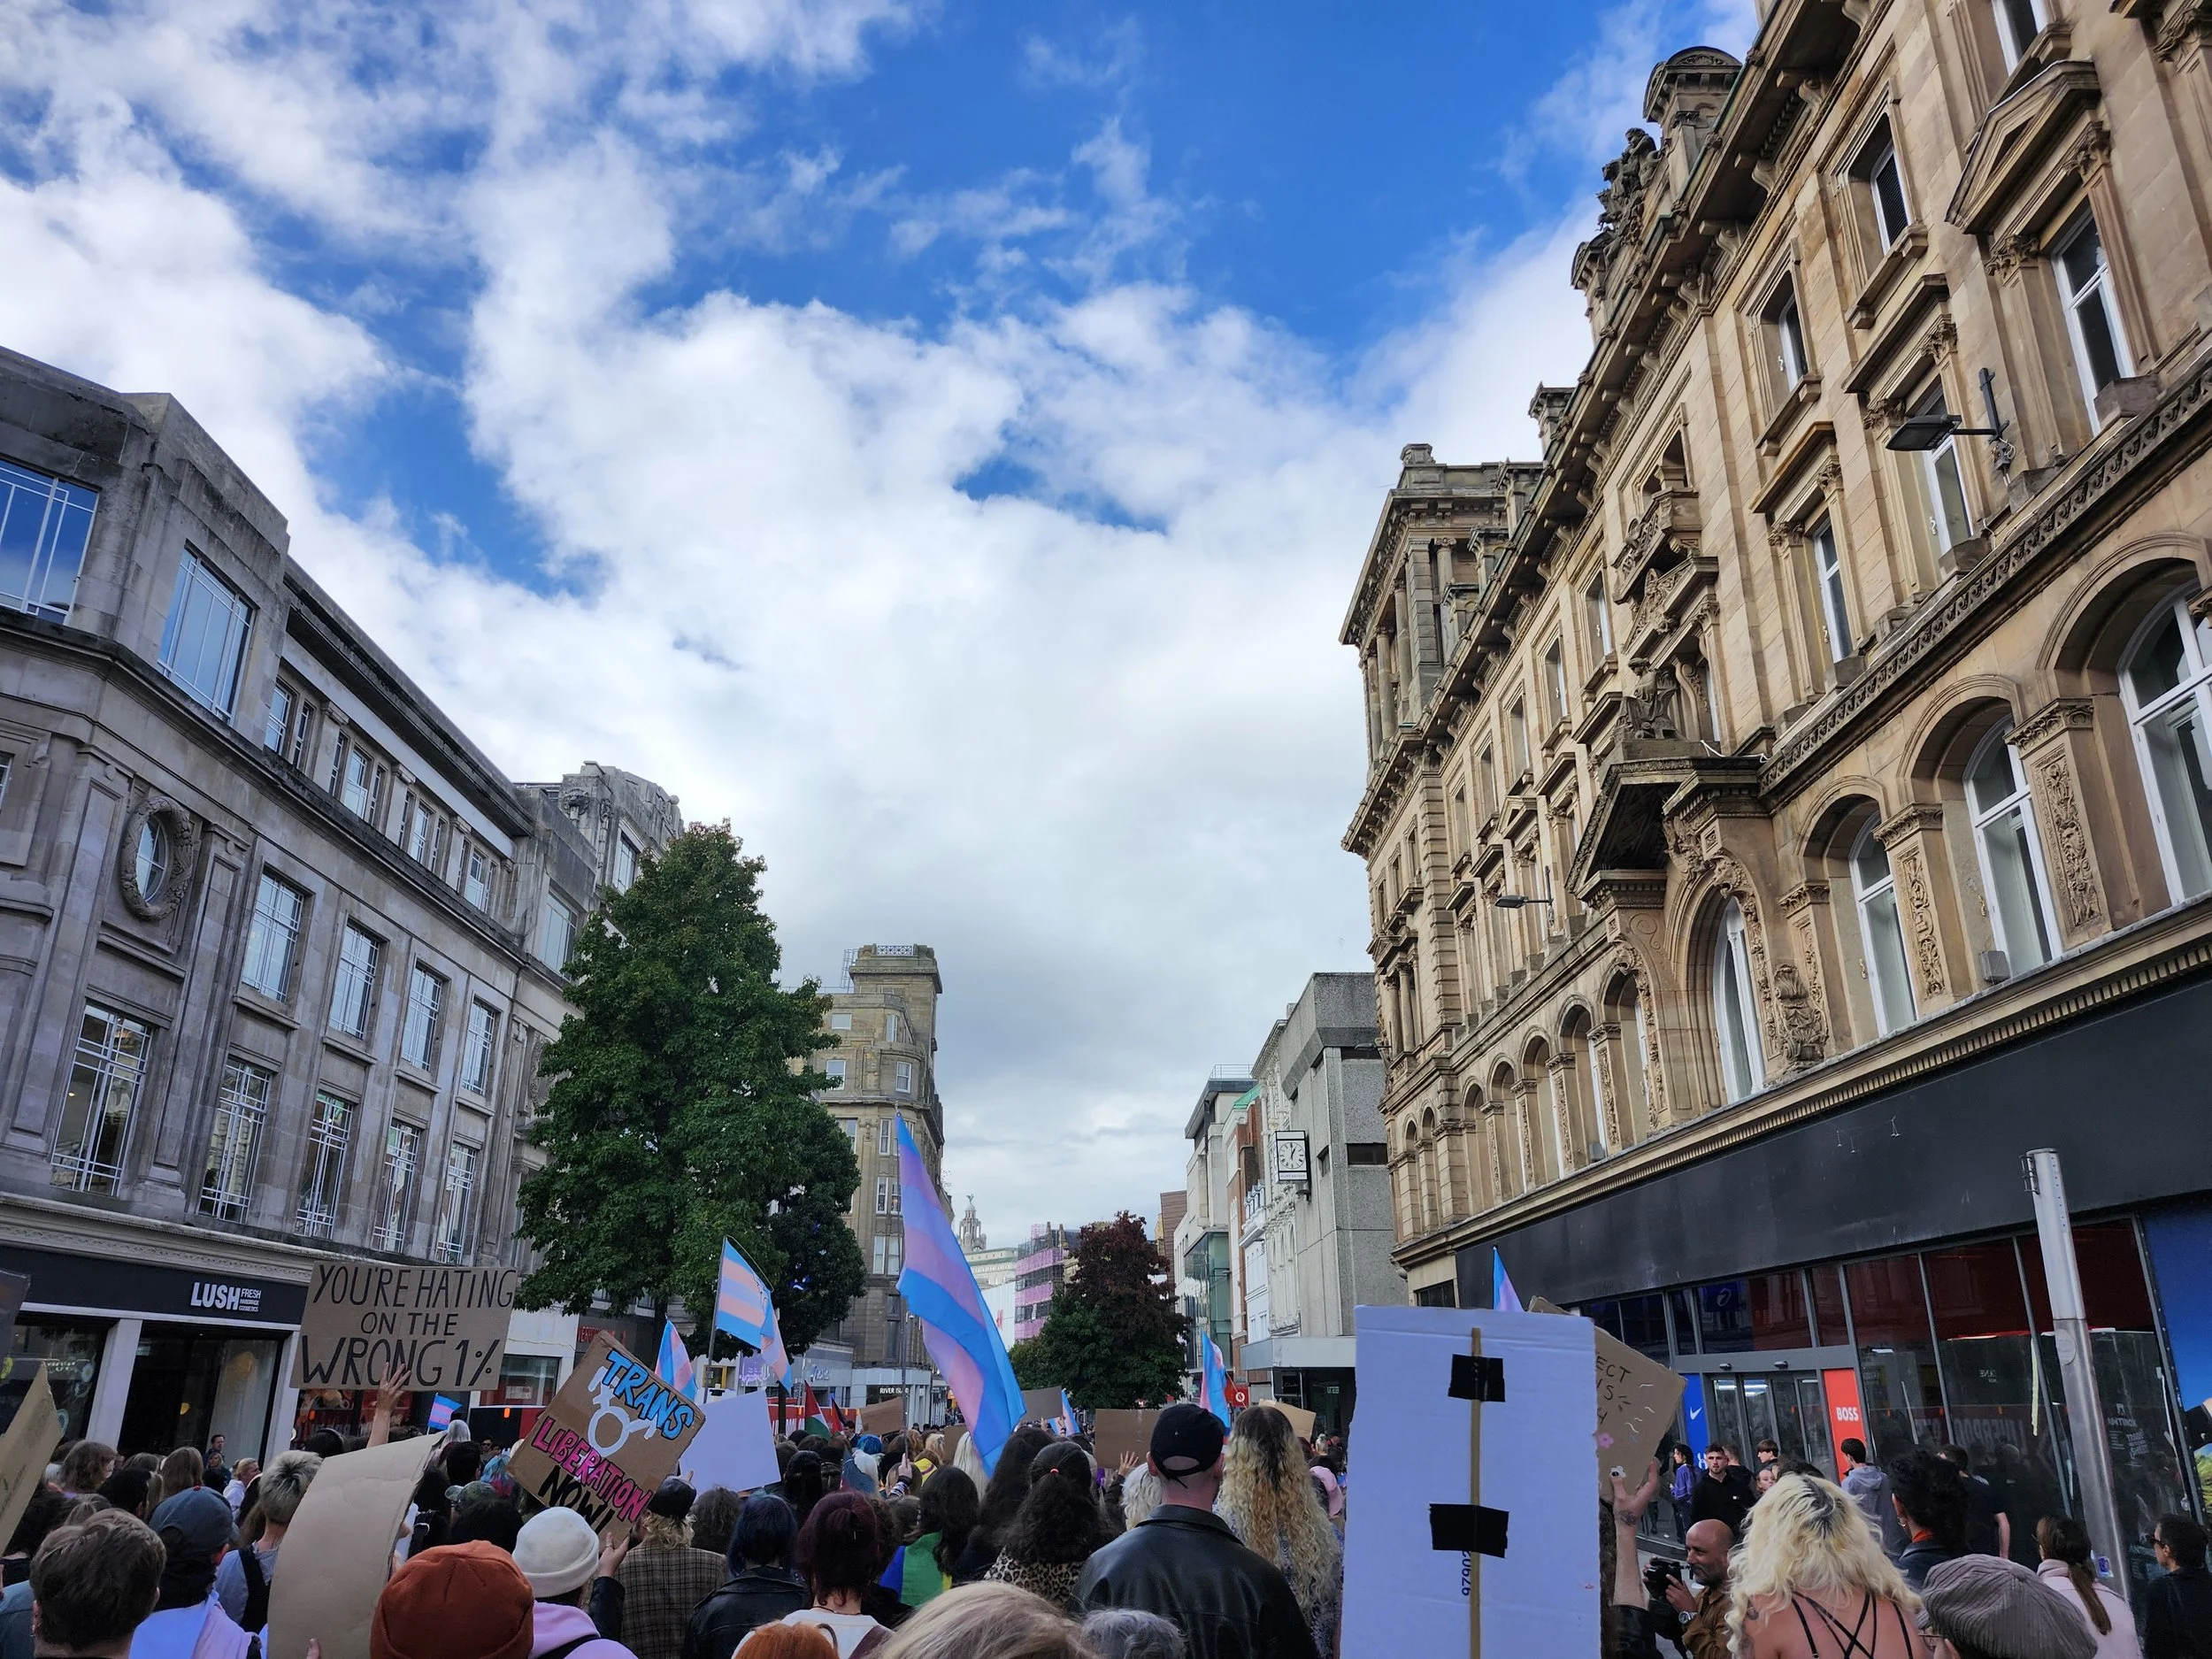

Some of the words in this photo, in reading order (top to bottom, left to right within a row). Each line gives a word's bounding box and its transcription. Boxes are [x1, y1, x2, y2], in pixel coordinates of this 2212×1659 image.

[190, 1282, 241, 1310] LUSH
[241, 1288, 262, 1299] FRESH
[312, 1263, 411, 1307] YOU'RE
[414, 1269, 516, 1309] HATING
[361, 1312, 396, 1334] ON
[407, 1313, 458, 1336] THE
[302, 1335, 446, 1387] WRONG
[455, 1340, 500, 1386] 1%
[602, 1348, 695, 1440] TRANS
[1835, 1406, 1859, 1422] BOSS
[531, 1416, 654, 1524] LIBERATION
[538, 1464, 615, 1535] NOW!
